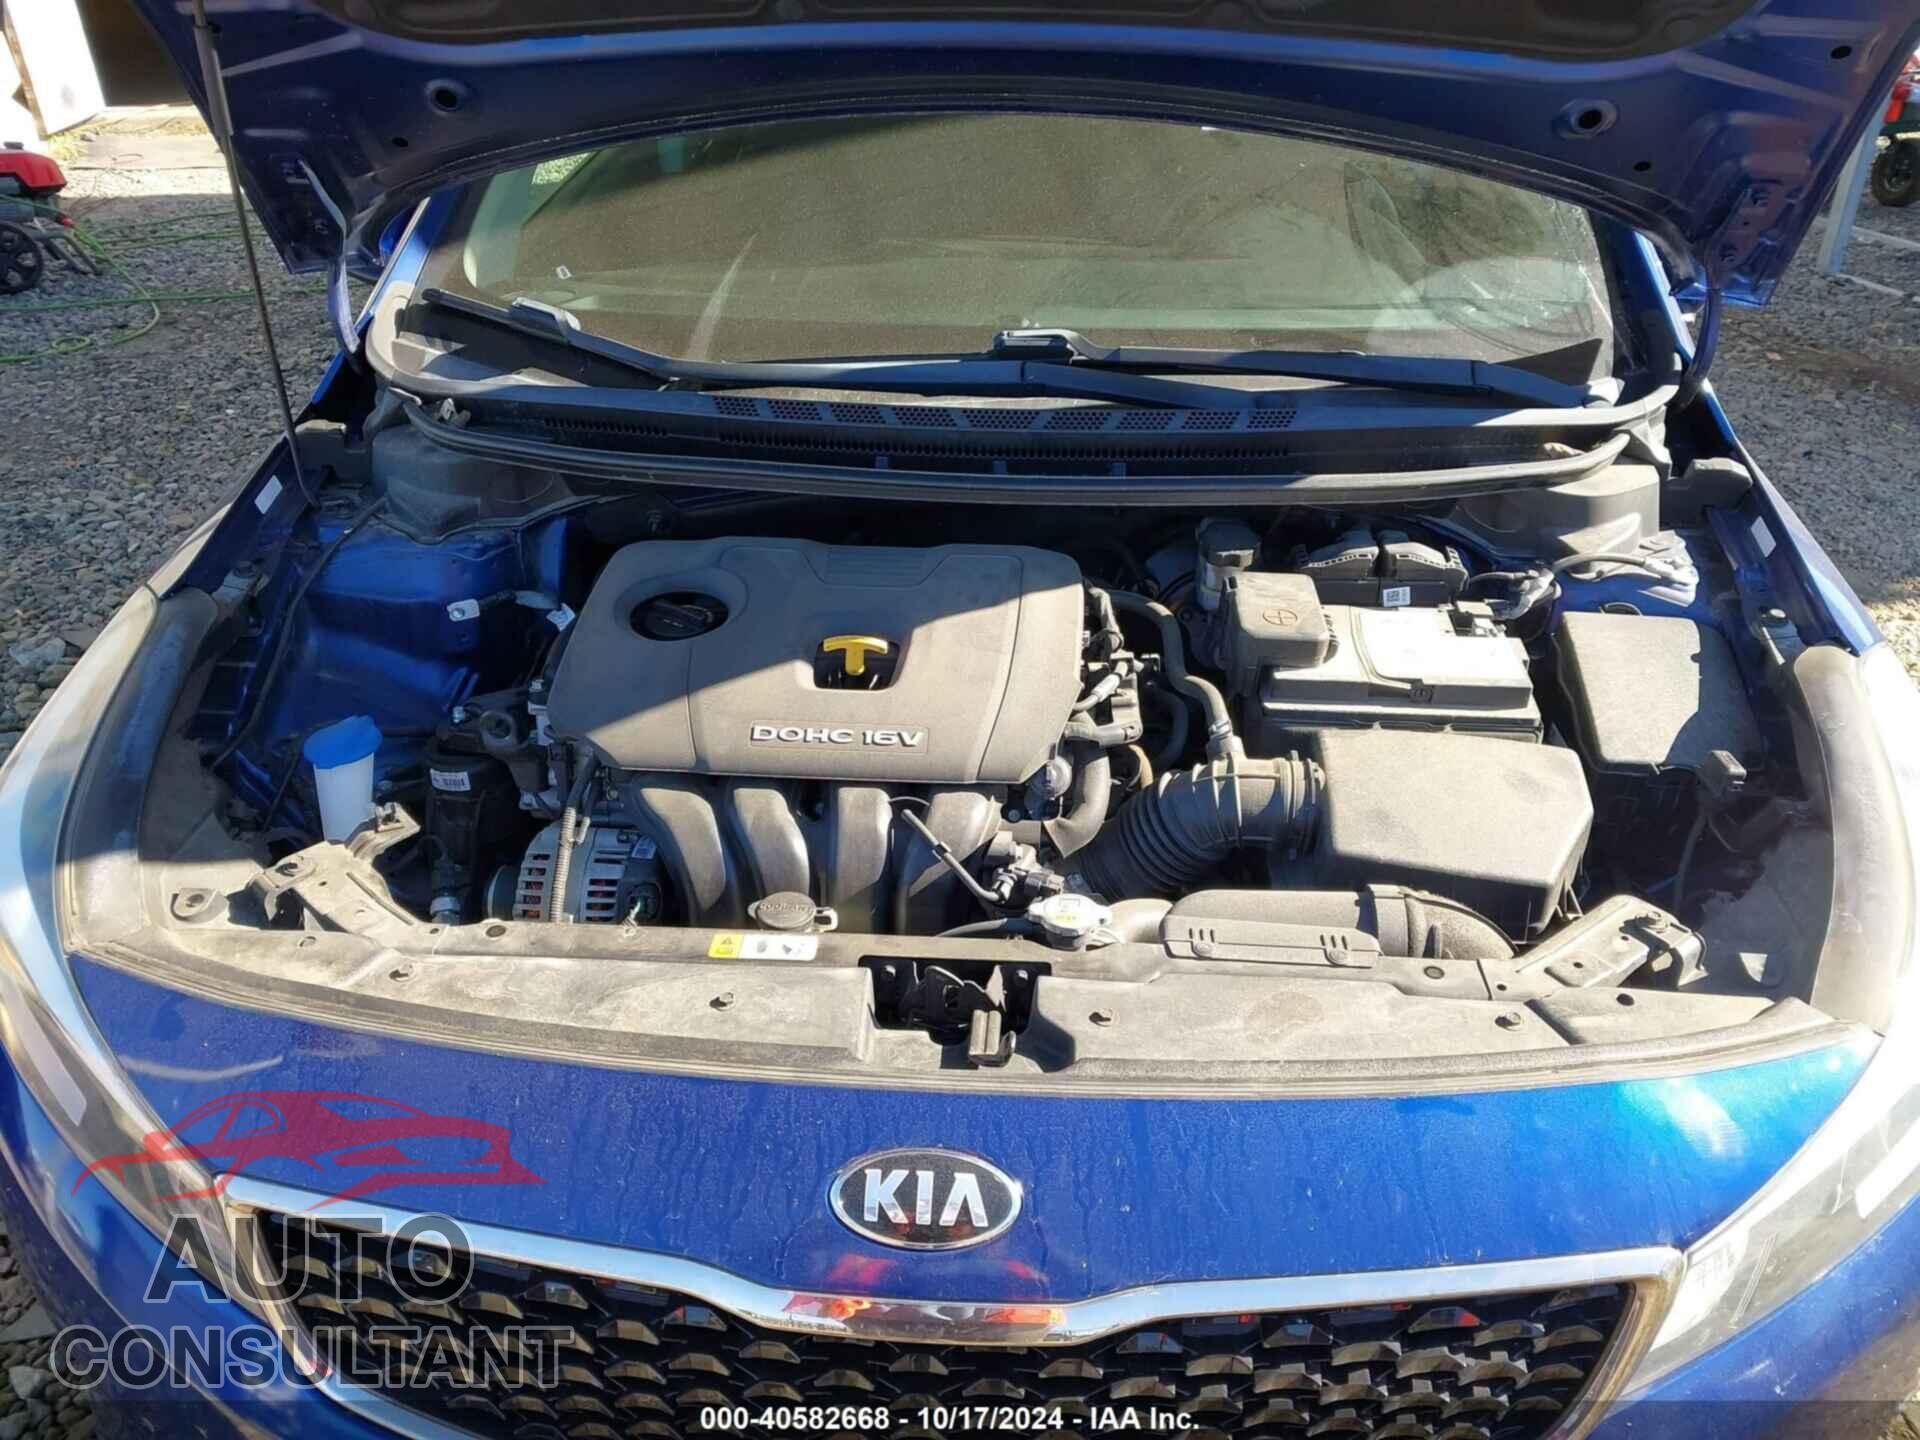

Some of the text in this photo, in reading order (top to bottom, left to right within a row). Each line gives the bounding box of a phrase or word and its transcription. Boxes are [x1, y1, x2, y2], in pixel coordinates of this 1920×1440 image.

[751, 725, 924, 747] DOHC 16V
[863, 1168, 989, 1228] KIA
